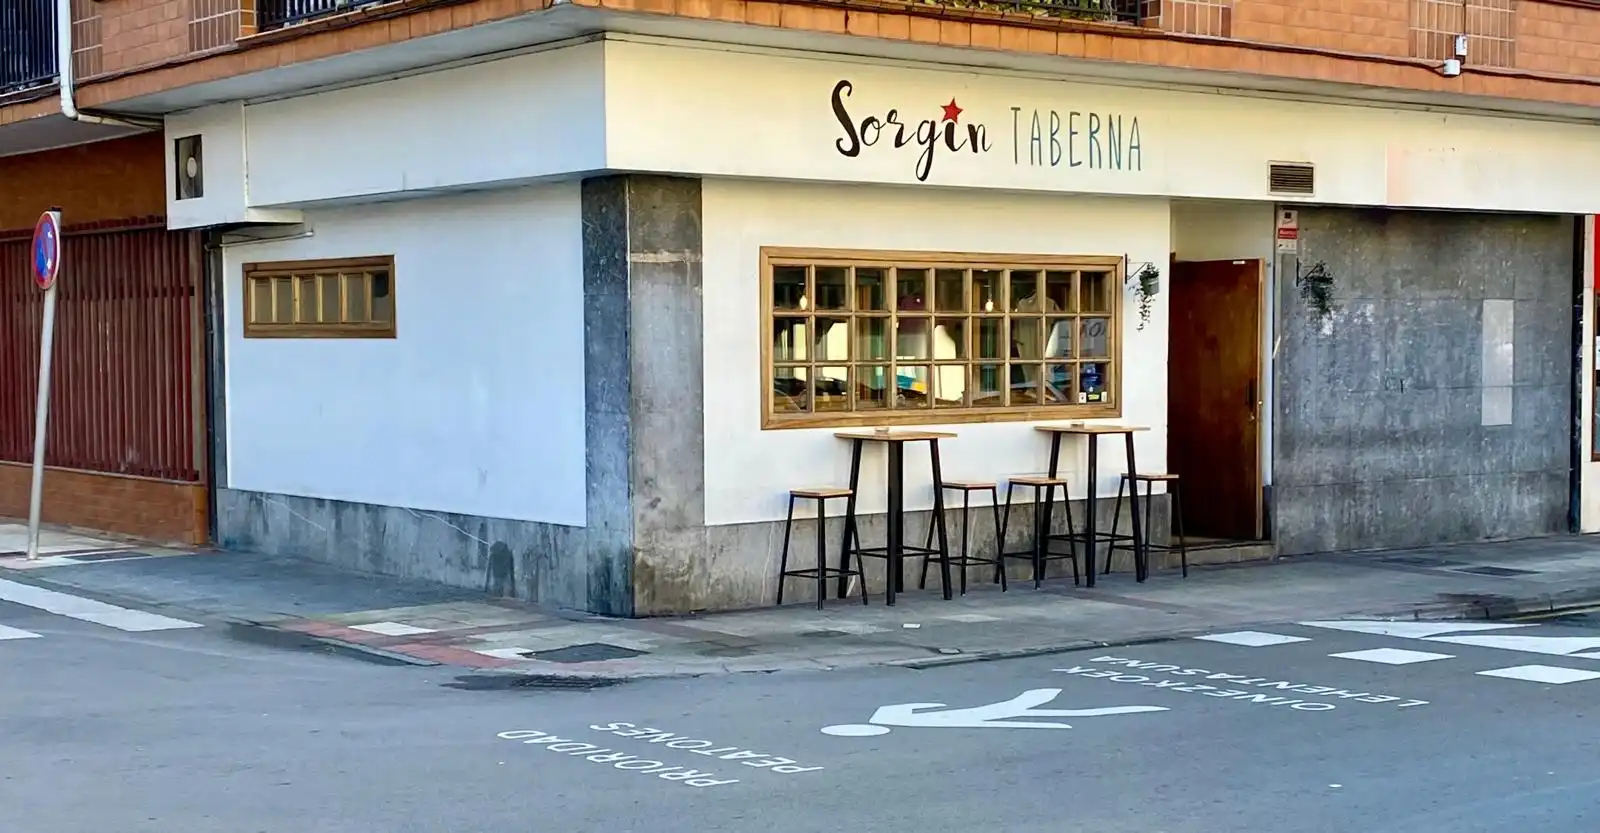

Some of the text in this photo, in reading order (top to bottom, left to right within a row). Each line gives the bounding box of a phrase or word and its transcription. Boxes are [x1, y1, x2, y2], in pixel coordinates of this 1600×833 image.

[831, 79, 1141, 181] Sorgin TABERNA
[1051, 665, 1337, 711] OINEZKOEK
[1088, 655, 1430, 708] LEHENTASUNA
[496, 729, 740, 788] PRIORIDAD
[589, 721, 825, 774] PEATONES
